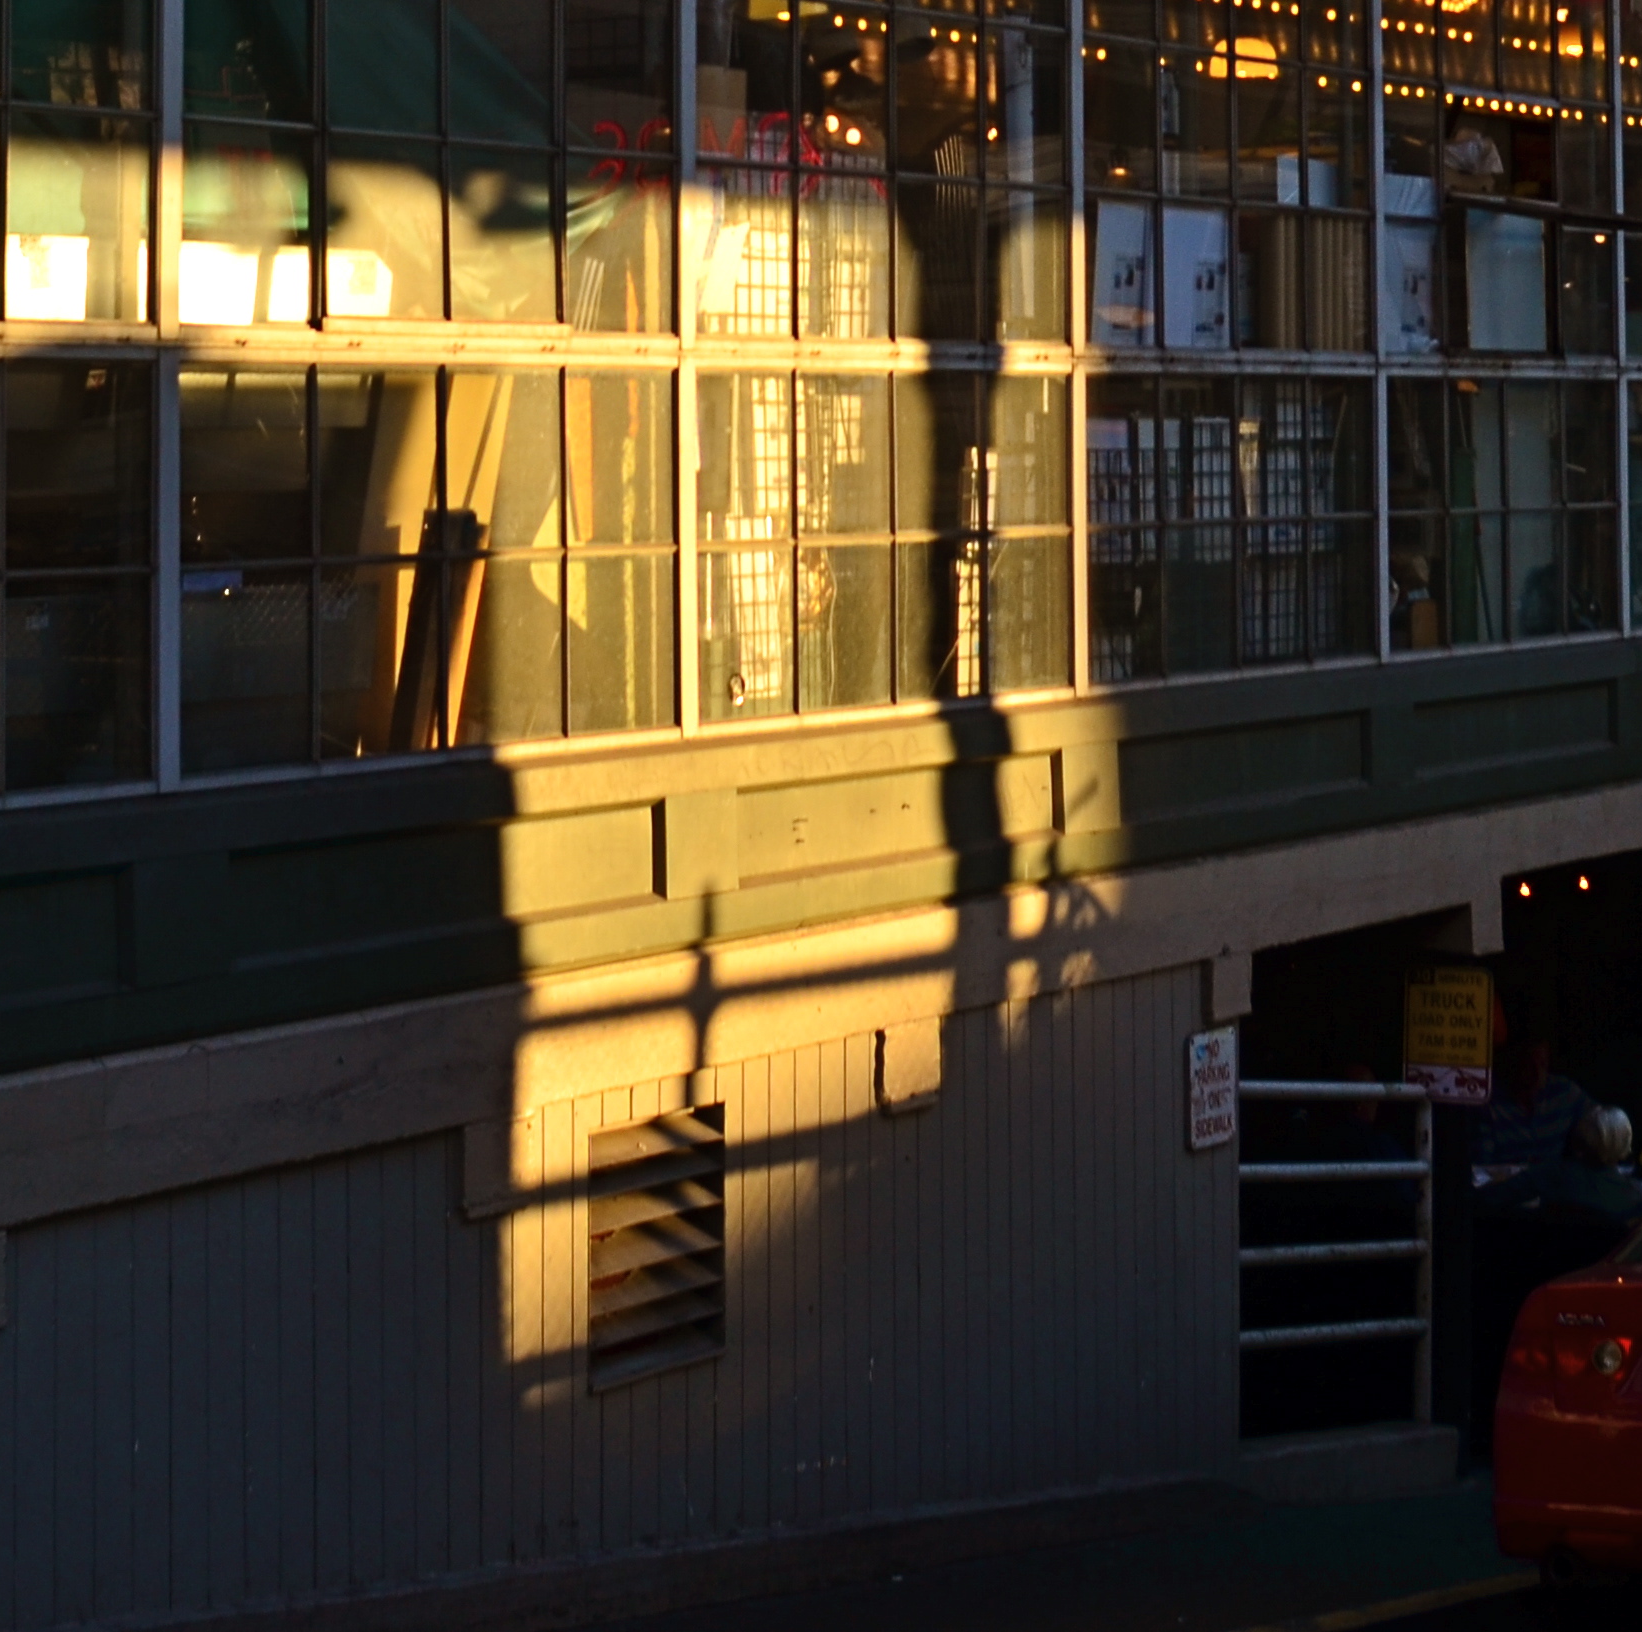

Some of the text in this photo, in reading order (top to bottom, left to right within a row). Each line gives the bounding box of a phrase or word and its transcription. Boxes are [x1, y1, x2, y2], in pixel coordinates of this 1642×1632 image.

[1419, 989, 1477, 1010] TRUCK
[1411, 1012, 1482, 1029] LOAD ONLY
[1198, 1063, 1231, 1086] PARKING
[1194, 1113, 1234, 1139] SIDEWALK
